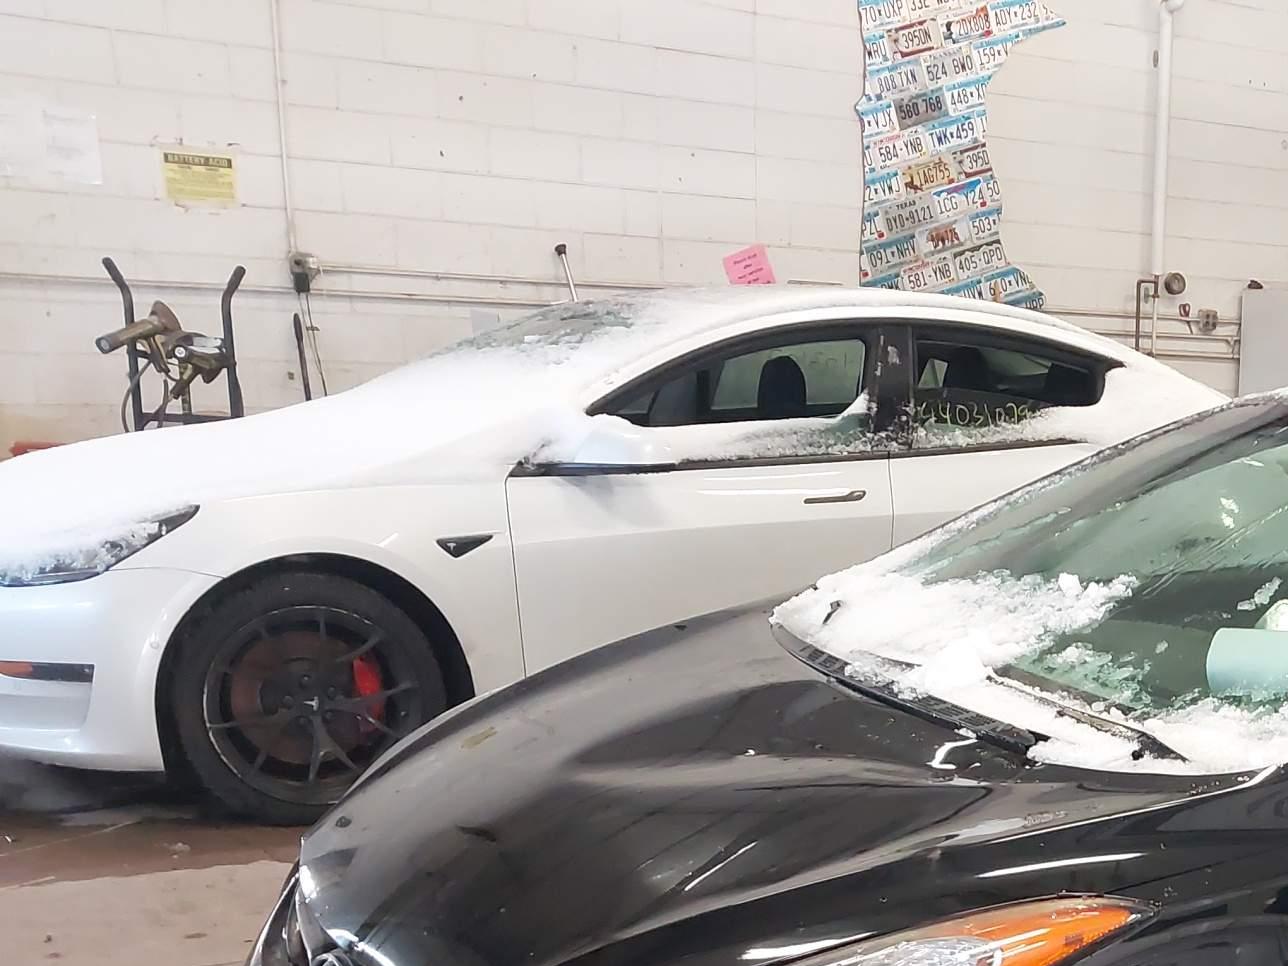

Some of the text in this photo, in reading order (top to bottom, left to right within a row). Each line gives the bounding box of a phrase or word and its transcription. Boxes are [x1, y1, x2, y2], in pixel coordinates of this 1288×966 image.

[1019, 2, 1039, 21] 232
[877, 67, 918, 93] 808 TXN
[926, 61, 948, 82] 524
[923, 95, 943, 114] 768
[950, 88, 969, 107] 448
[928, 127, 951, 149] TWK
[955, 121, 976, 141] 459
